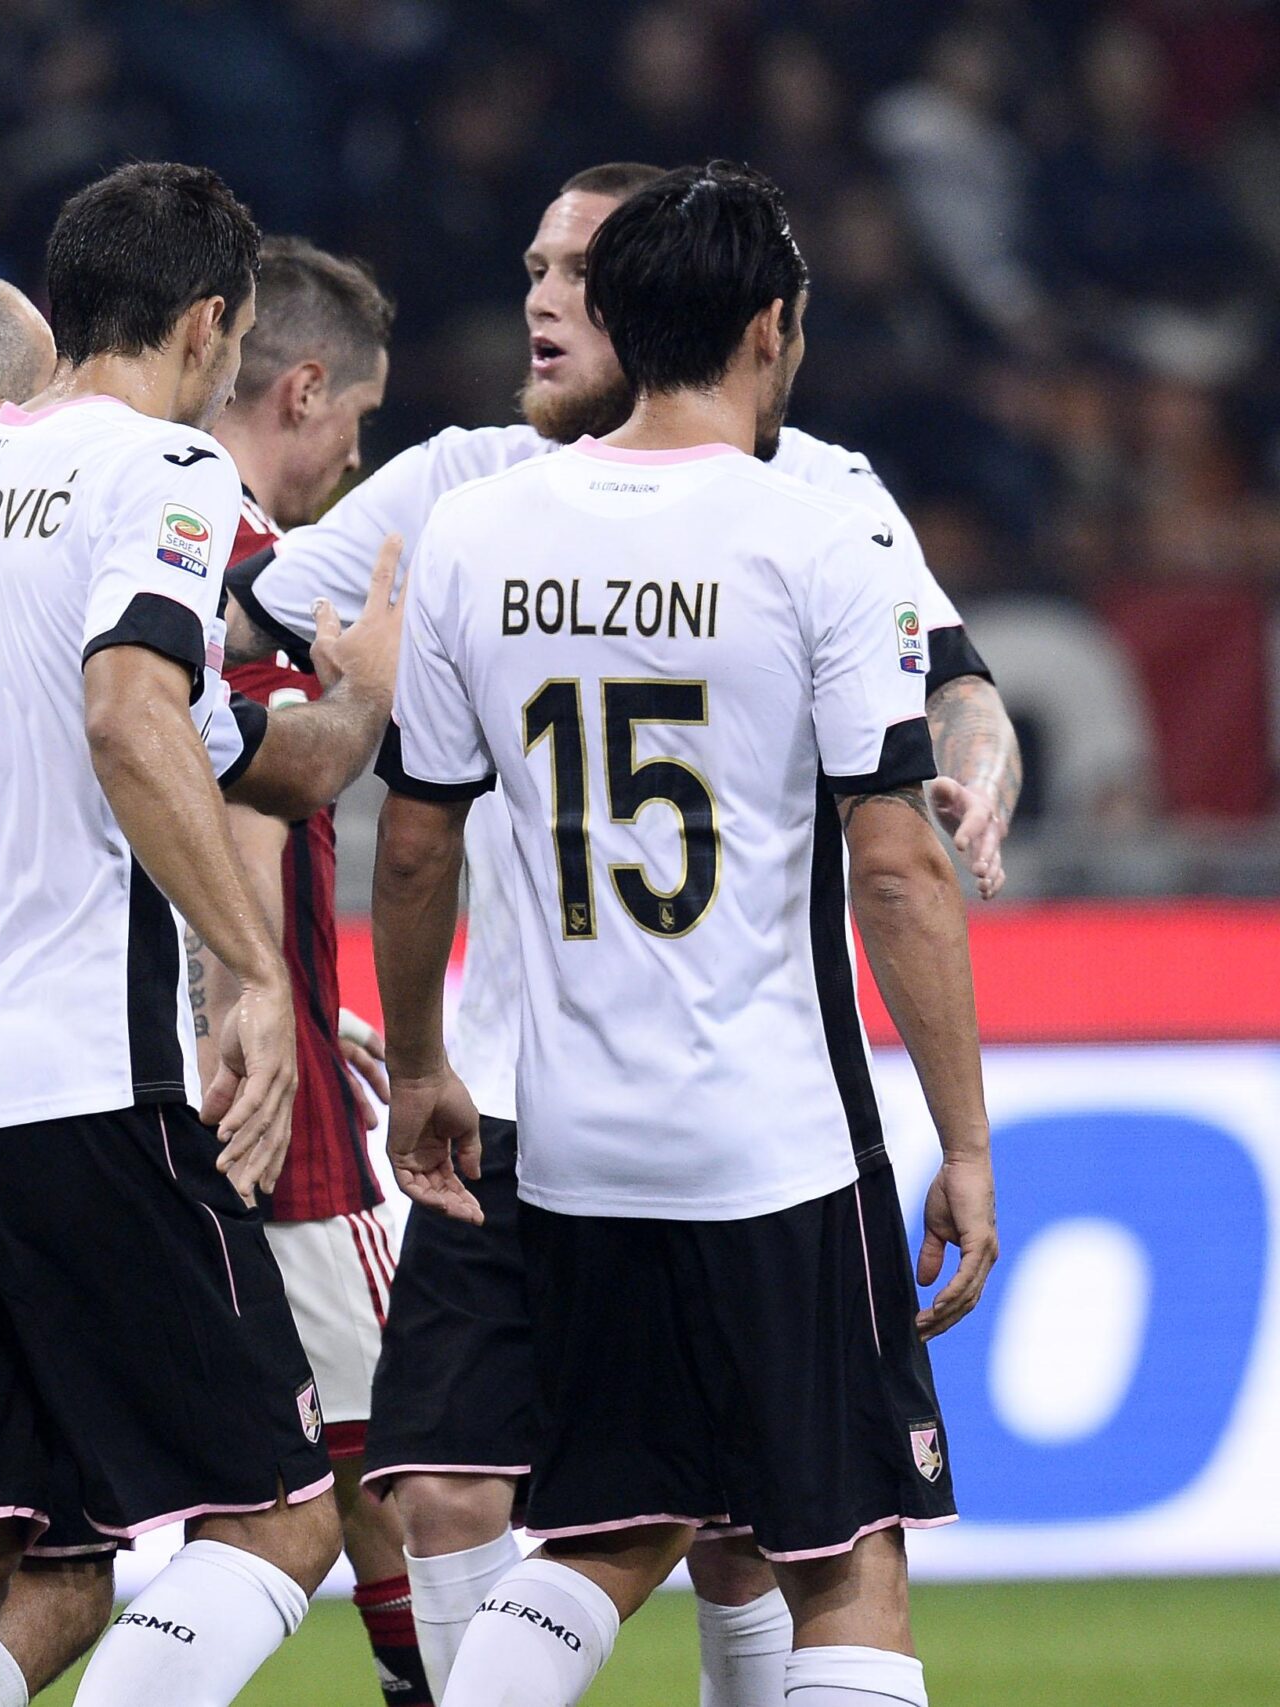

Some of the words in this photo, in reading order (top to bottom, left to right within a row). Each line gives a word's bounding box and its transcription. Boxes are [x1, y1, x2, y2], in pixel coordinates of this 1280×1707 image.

[166, 533, 194, 553] SERIE
[181, 556, 204, 575] TIM
[502, 578, 720, 639] BOLZONI
[522, 677, 721, 941] 15
